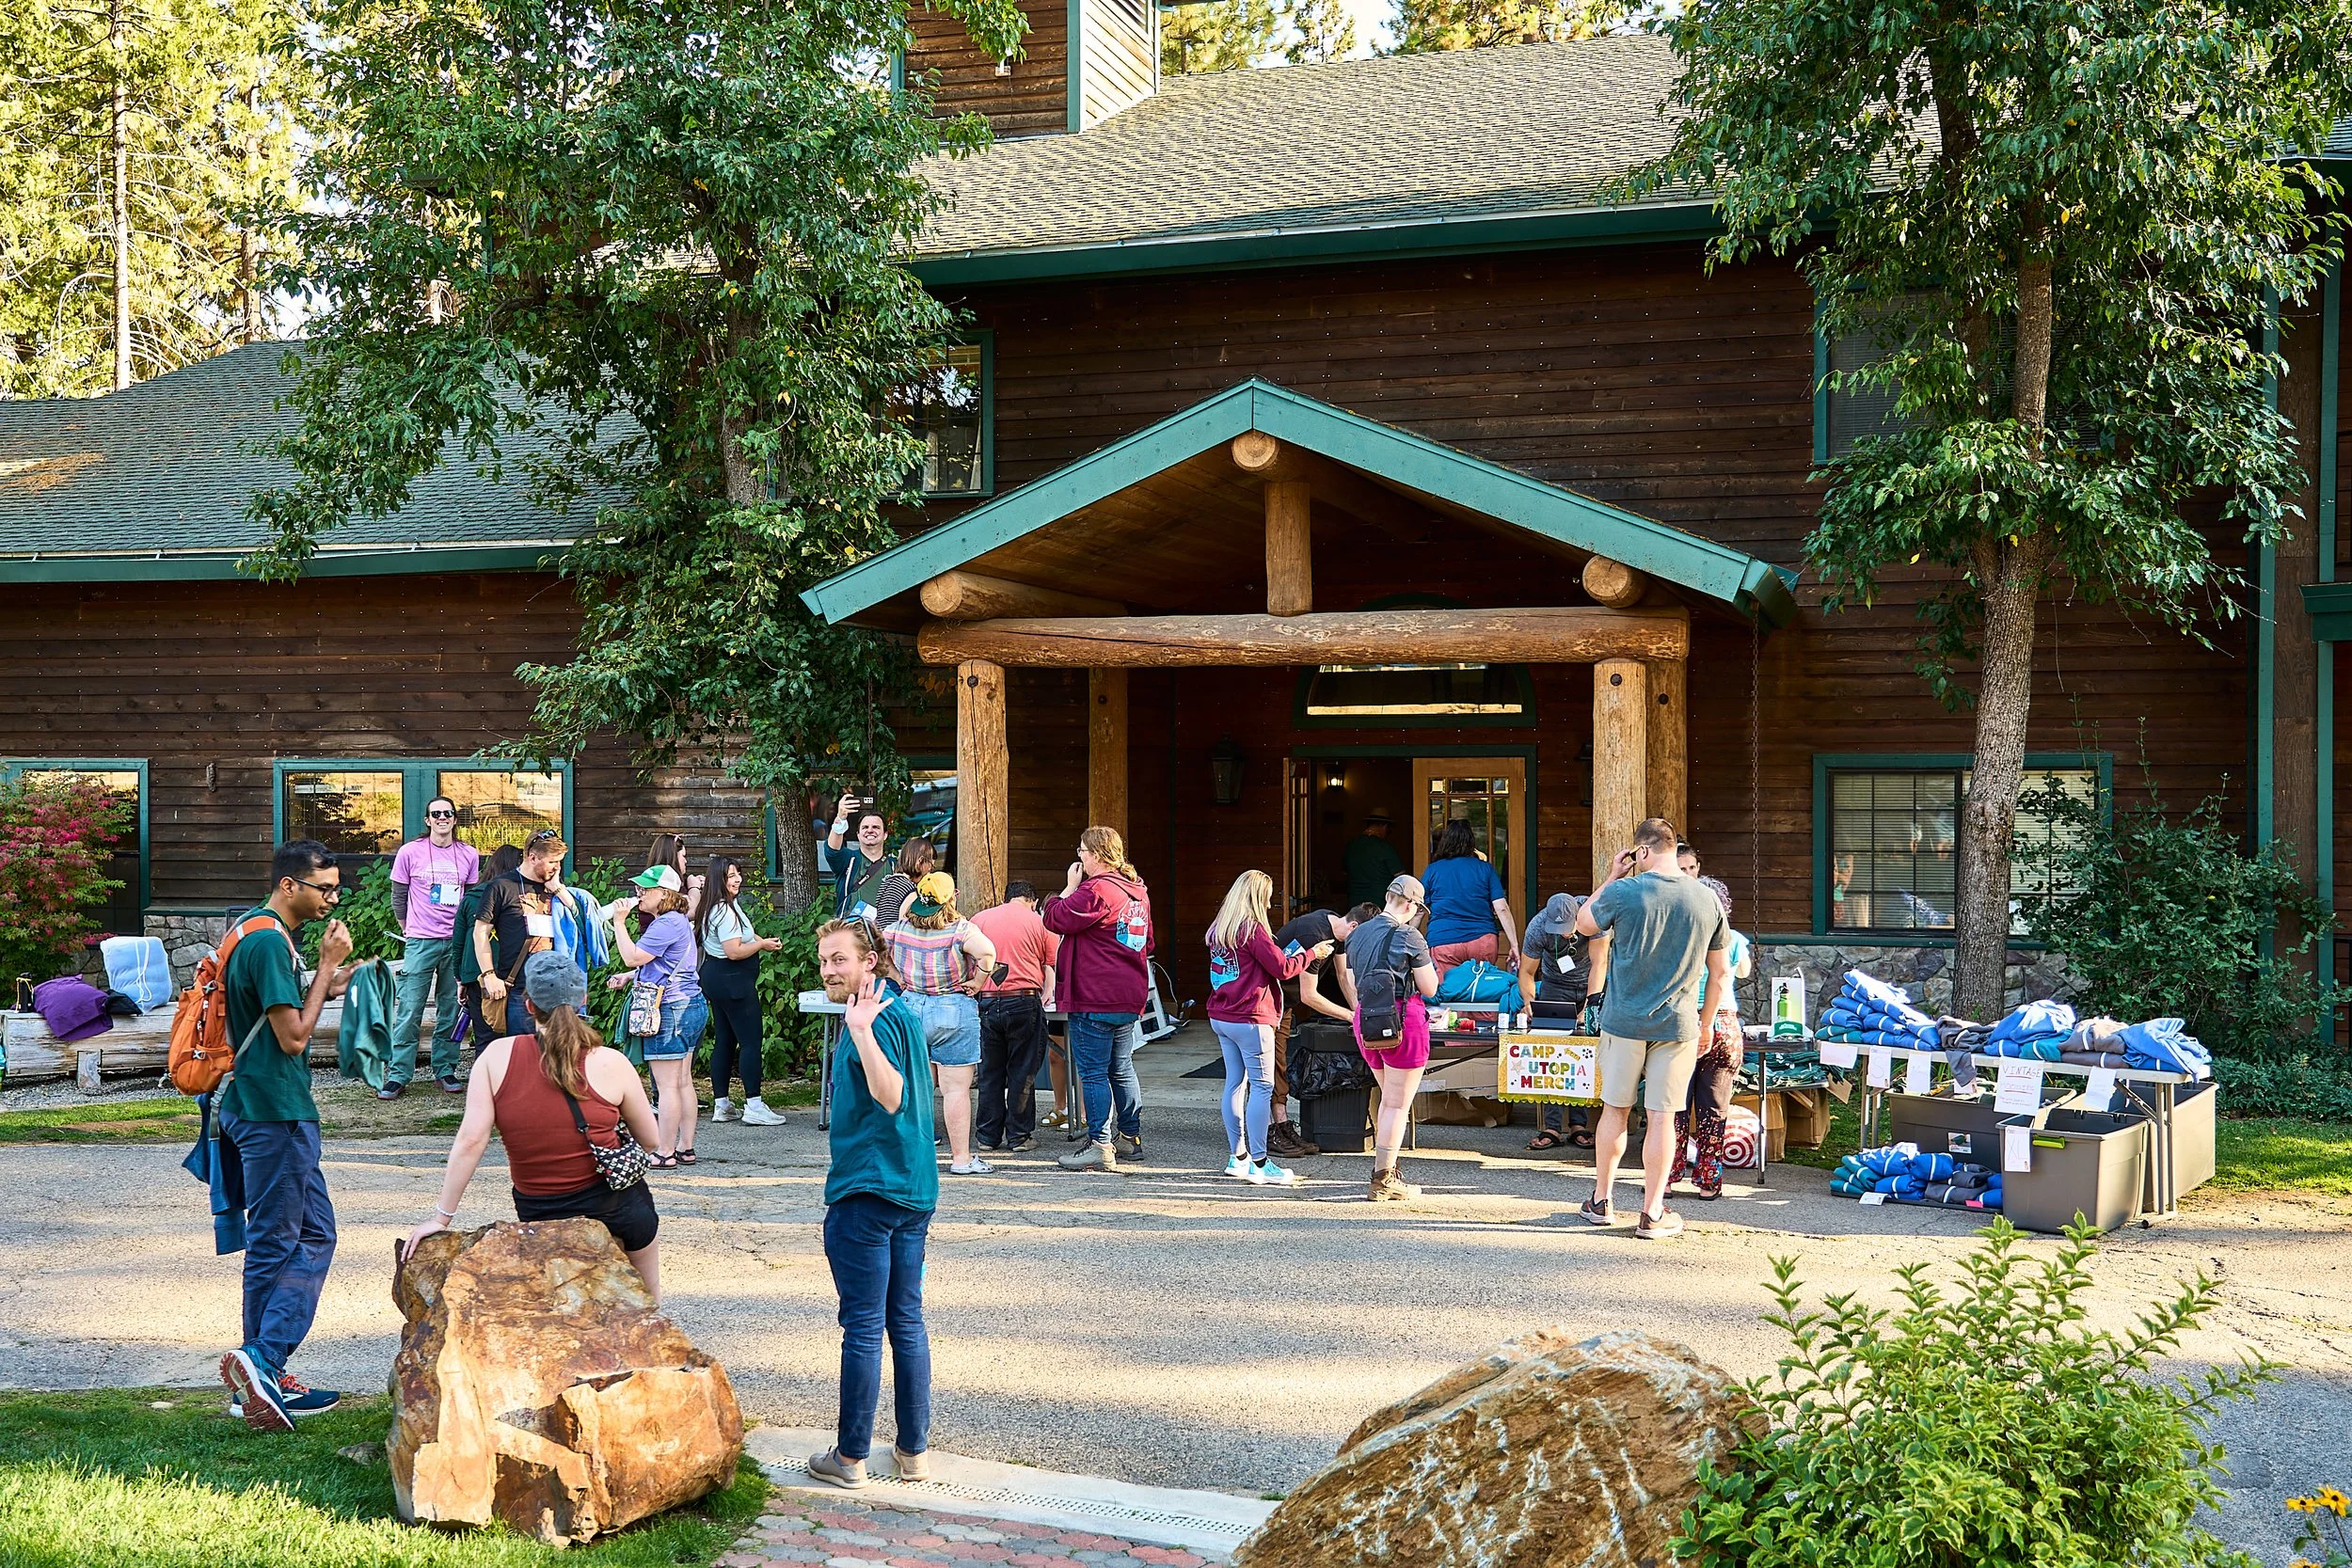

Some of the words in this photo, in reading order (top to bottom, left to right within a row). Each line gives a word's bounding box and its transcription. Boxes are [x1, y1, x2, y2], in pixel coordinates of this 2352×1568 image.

[1509, 1045, 1555, 1058] CAMP
[1529, 1061, 1586, 1075] UTOPIA
[2003, 1066, 2042, 1077] VINTAGE
[1520, 1075, 1575, 1090] MERCH
